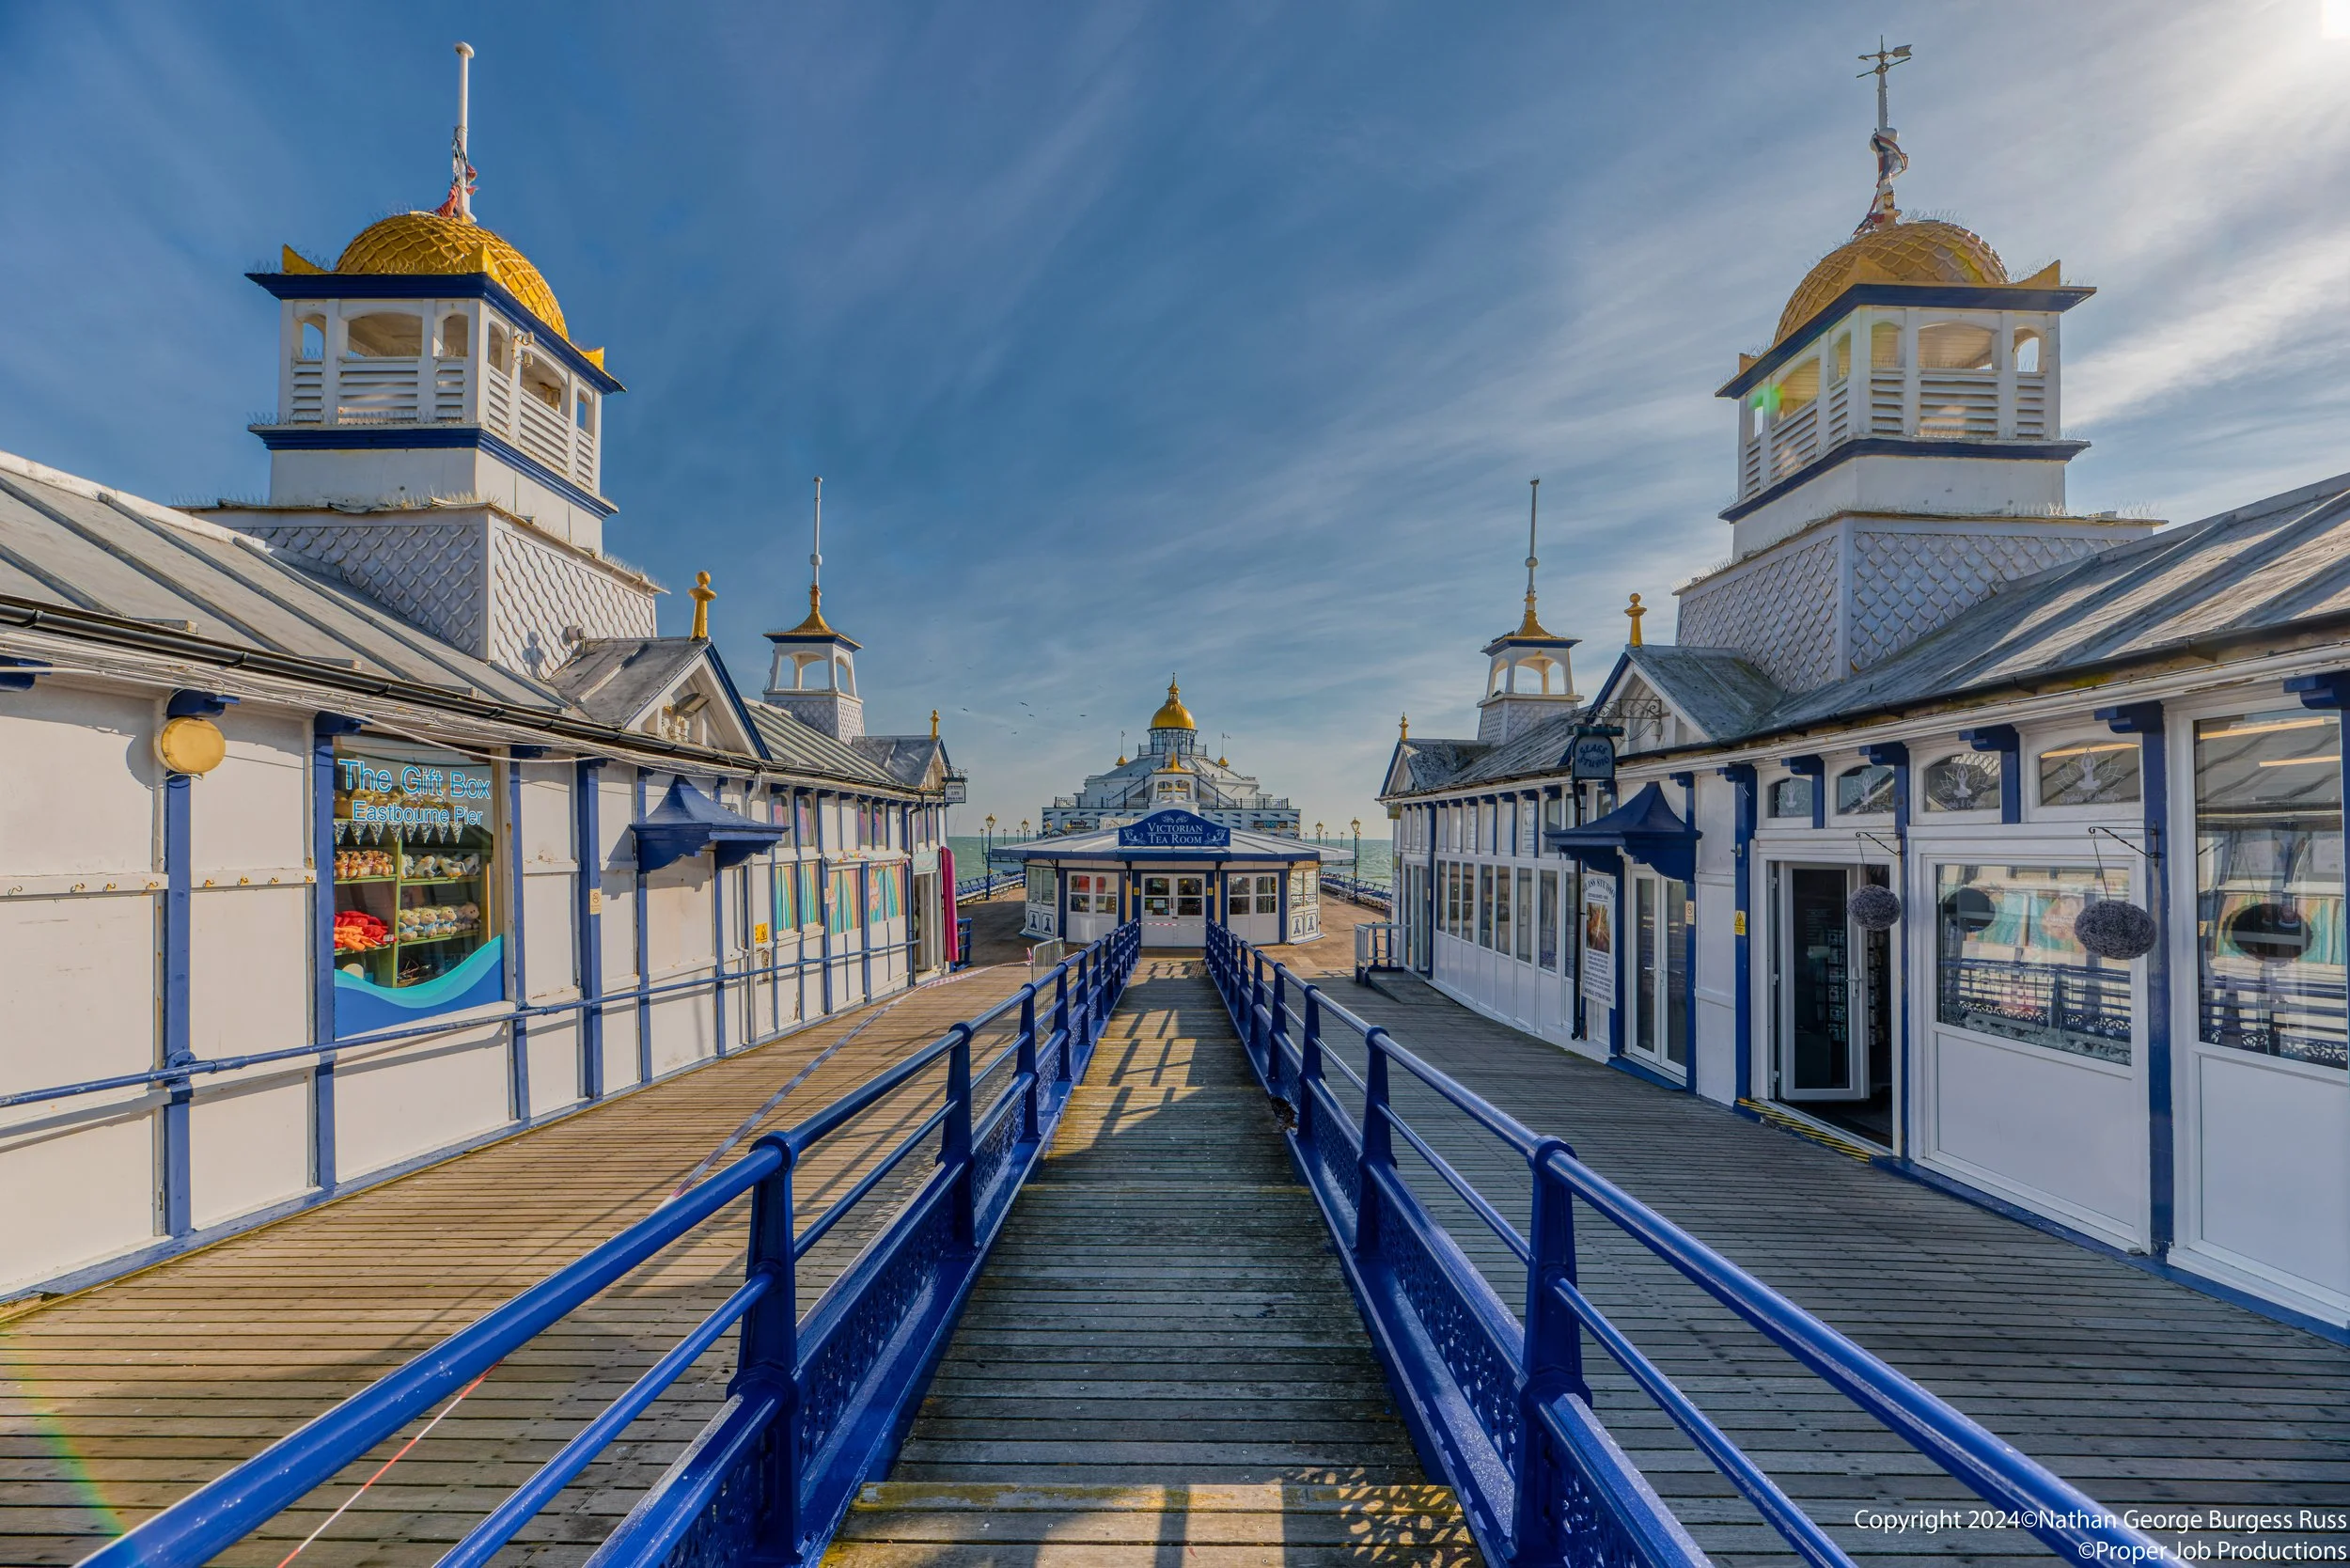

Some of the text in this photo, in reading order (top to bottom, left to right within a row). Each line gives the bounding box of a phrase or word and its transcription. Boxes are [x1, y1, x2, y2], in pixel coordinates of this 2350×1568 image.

[1579, 744, 1607, 755] GLASS
[1578, 753, 1610, 768] STUDIO
[337, 758, 491, 800] The Gift Box
[352, 800, 482, 825] Eastbourne Pier
[1148, 823, 1203, 833] VICTORIAN
[1148, 834, 1202, 844] TEA ROOM
